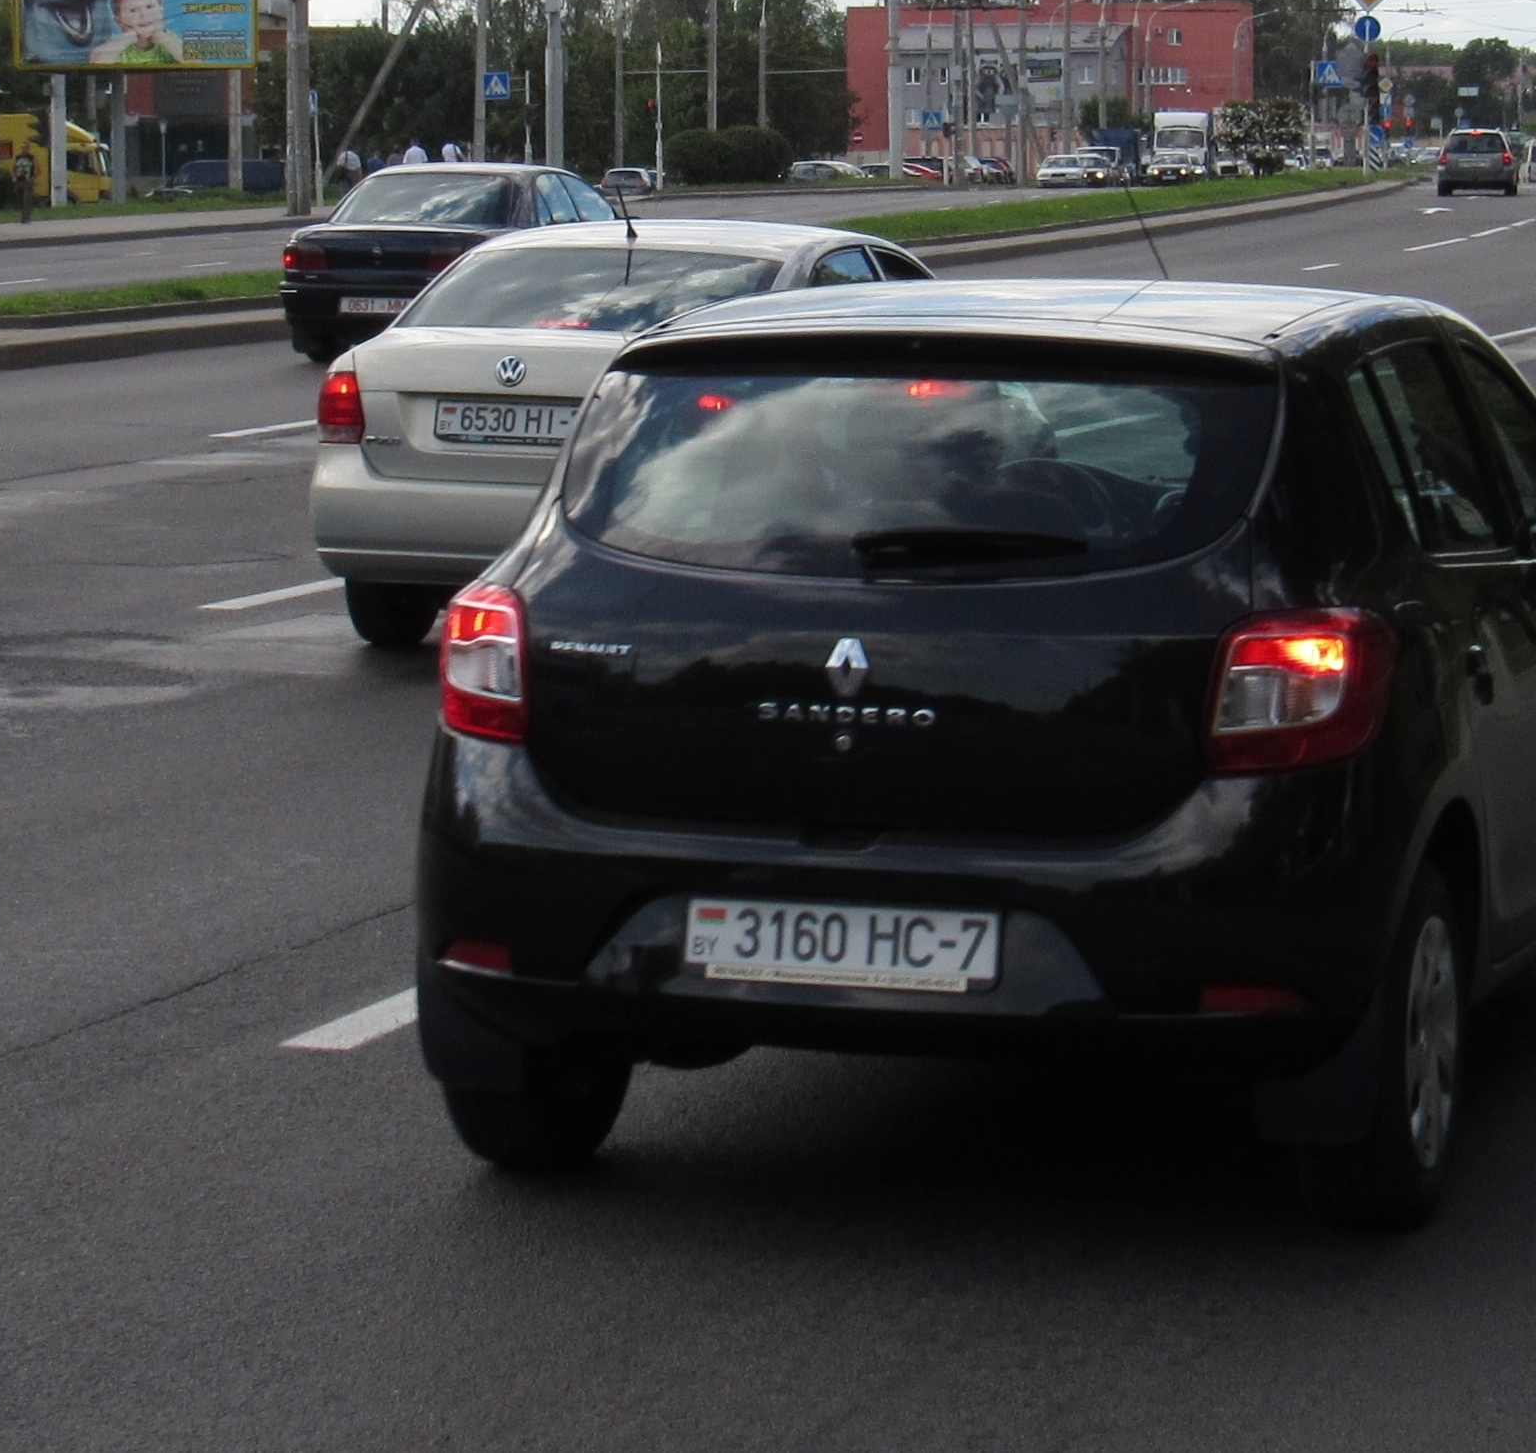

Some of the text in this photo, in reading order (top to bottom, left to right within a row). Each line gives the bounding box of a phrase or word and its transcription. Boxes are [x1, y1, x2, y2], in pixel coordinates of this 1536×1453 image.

[460, 406, 517, 432] 6530
[758, 702, 936, 727] SANDERO
[691, 907, 990, 972] BY 3160 HC-7
